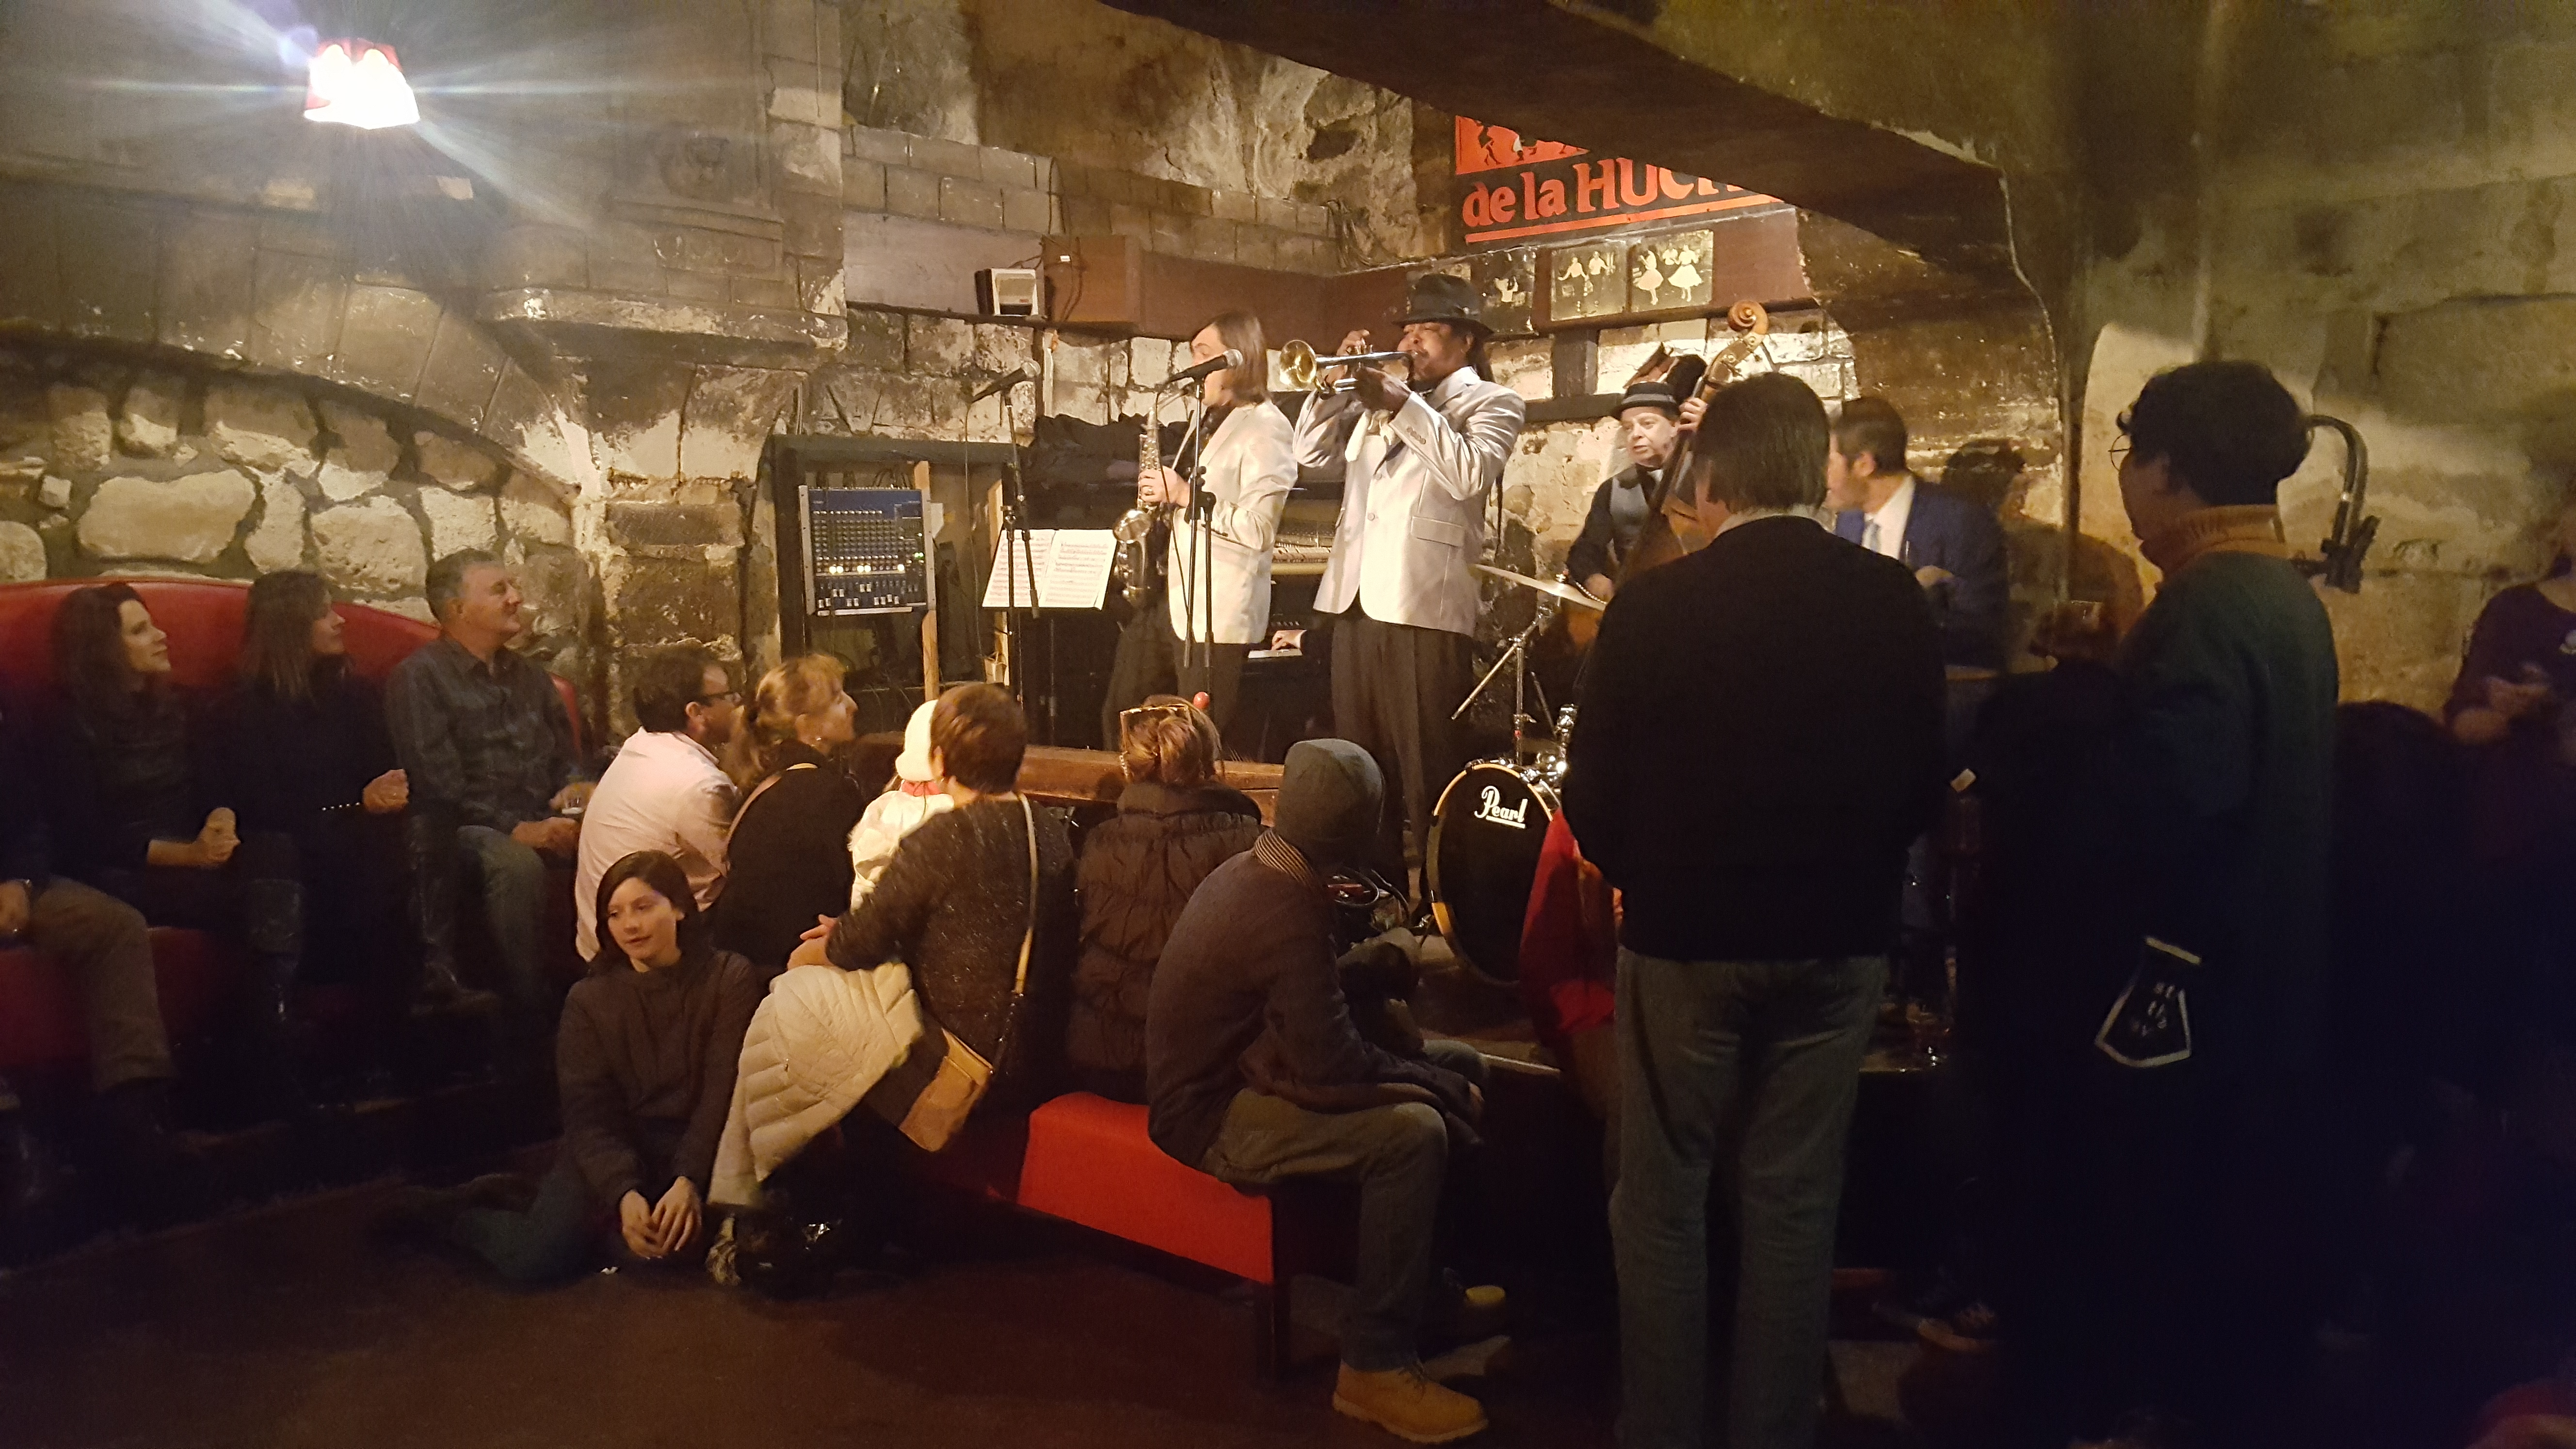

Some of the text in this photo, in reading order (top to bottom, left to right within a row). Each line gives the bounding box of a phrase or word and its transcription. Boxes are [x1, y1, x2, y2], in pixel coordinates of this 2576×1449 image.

[1462, 157, 1744, 227] de la HUC
[1474, 786, 1528, 822] Pearl
